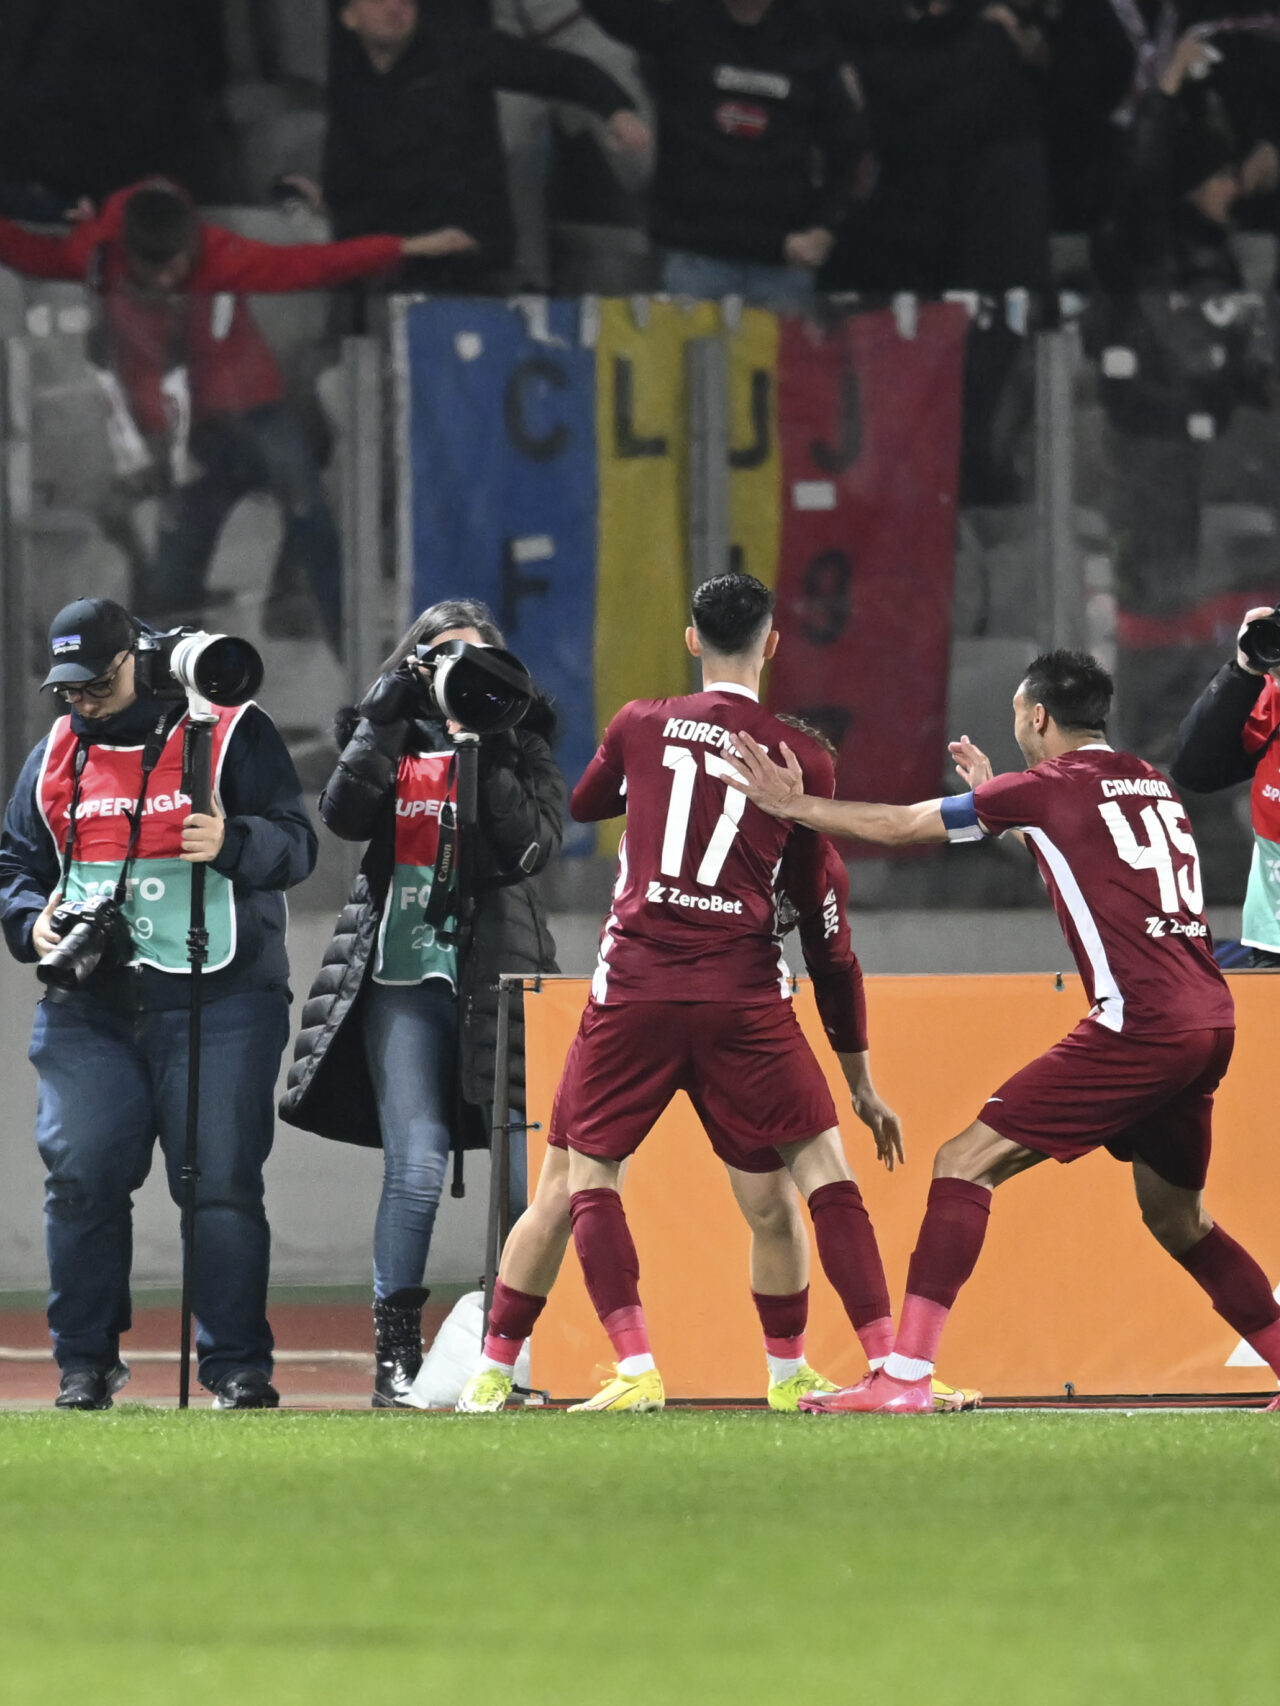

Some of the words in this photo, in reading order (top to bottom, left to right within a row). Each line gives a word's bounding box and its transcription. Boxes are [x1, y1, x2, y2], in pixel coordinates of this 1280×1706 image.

[662, 717, 770, 758] KOREN
[660, 745, 749, 887] 17
[438, 844, 452, 882] Canon
[1097, 799, 1204, 915] 45
[667, 887, 743, 915] ZeroBet
[823, 903, 840, 940] DSC
